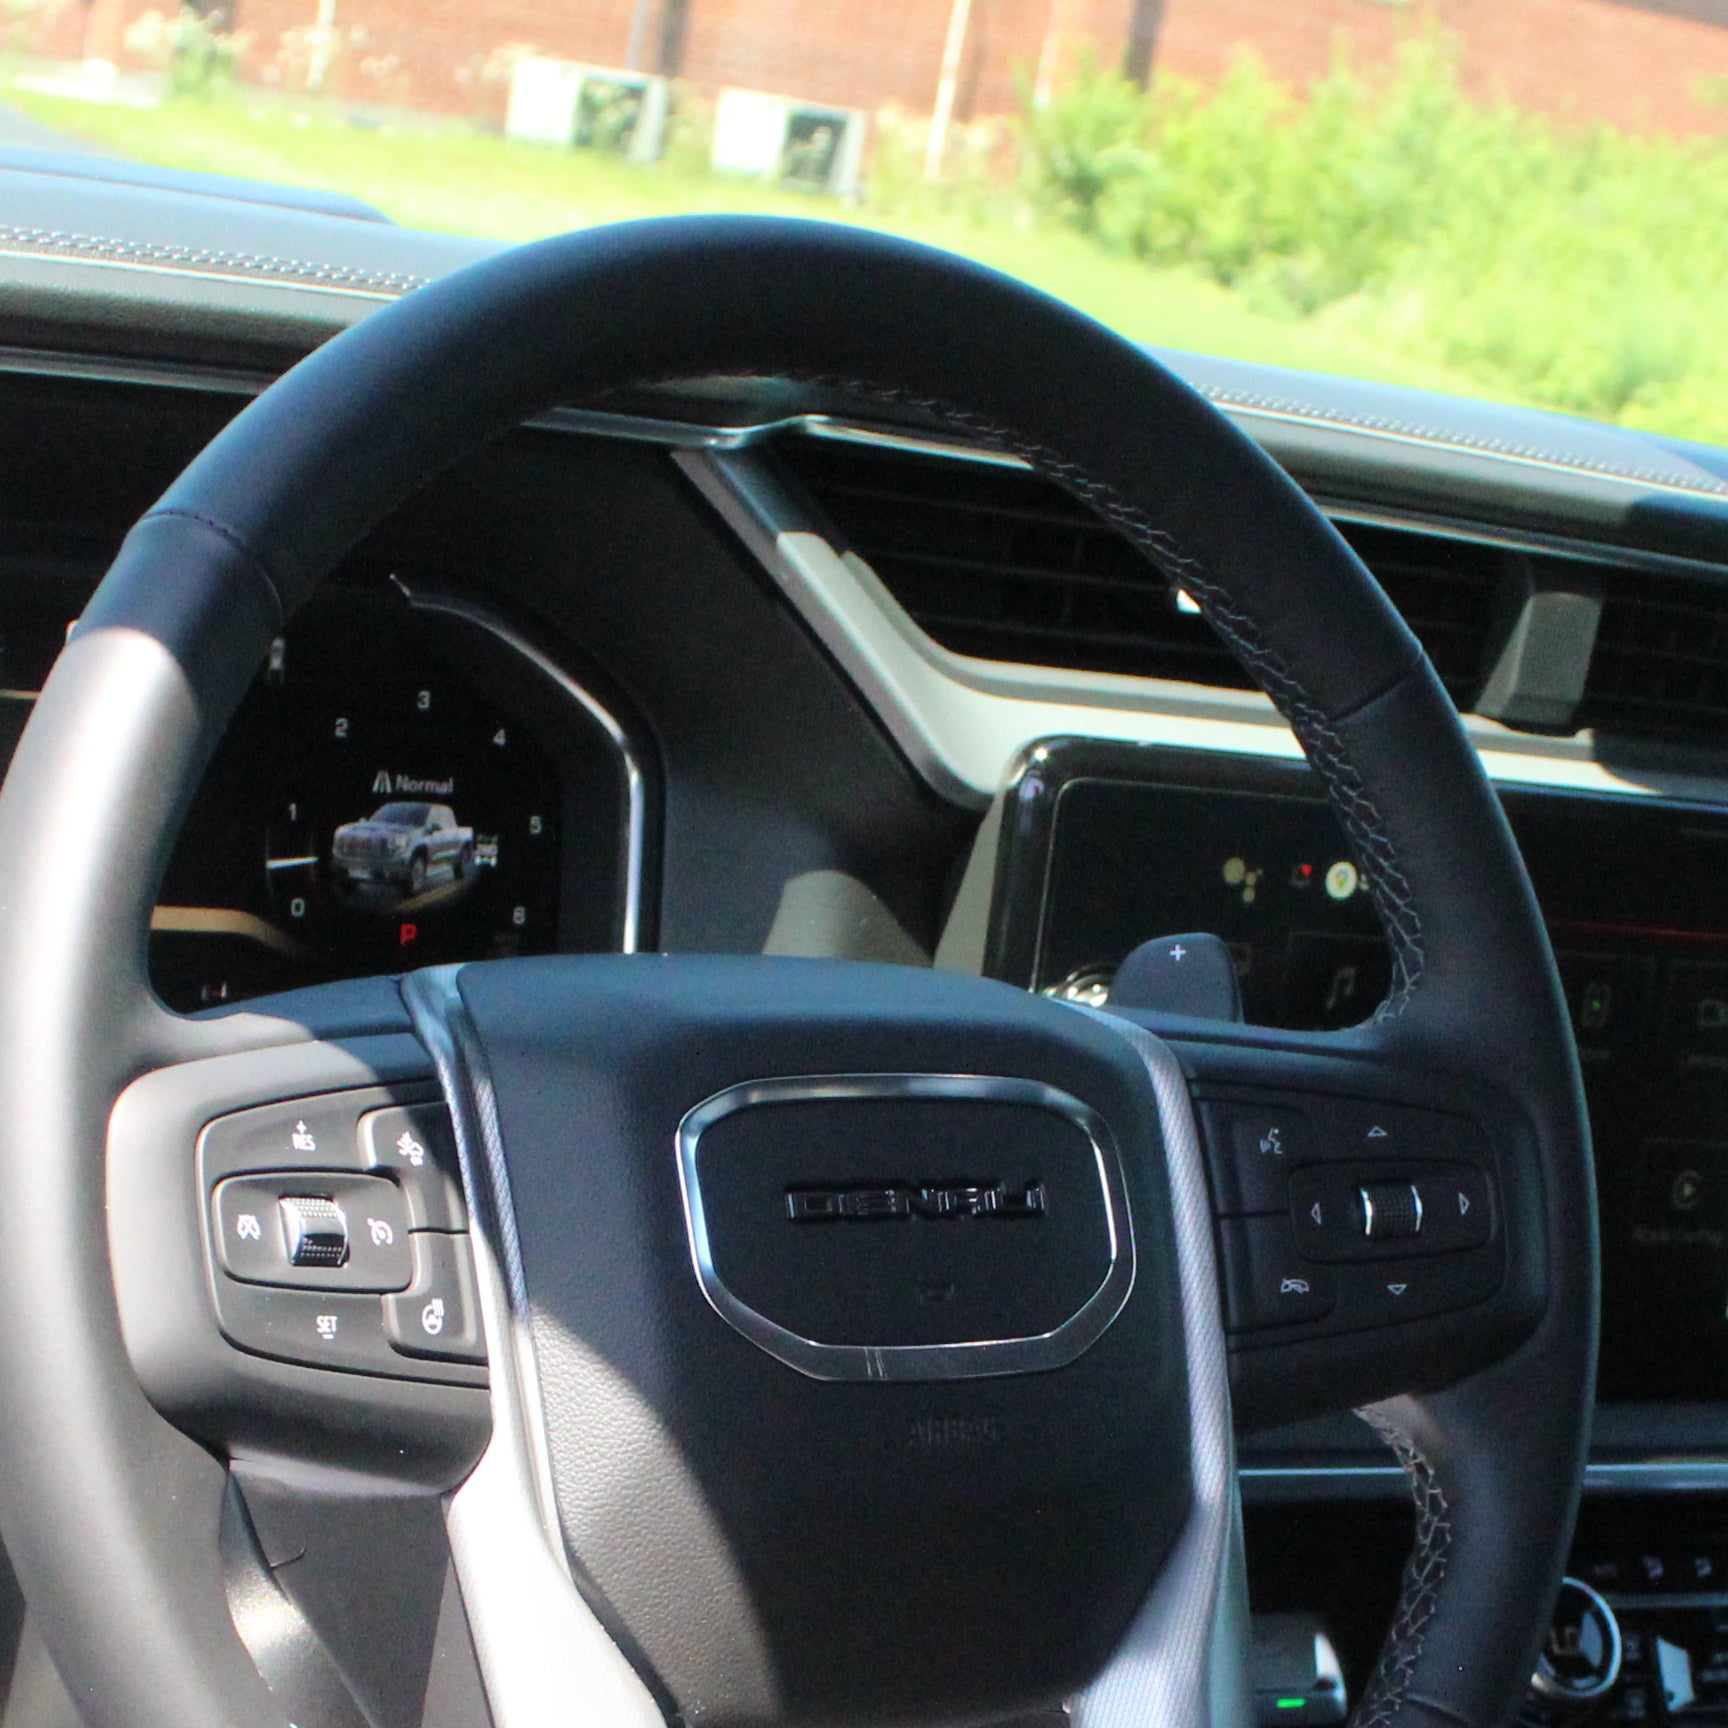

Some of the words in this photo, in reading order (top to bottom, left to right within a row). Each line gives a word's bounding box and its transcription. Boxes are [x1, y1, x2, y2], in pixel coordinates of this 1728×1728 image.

[417, 690, 431, 710] 3
[335, 718, 349, 738] 2
[493, 729, 506, 746] 4
[395, 775, 454, 794] Normal
[288, 803, 297, 821] 1
[529, 816, 542, 834] 5
[291, 898, 305, 917] 0
[512, 906, 526, 925] 6
[400, 924, 417, 944] P
[292, 1133, 316, 1151] RES
[316, 1315, 338, 1333] SET
